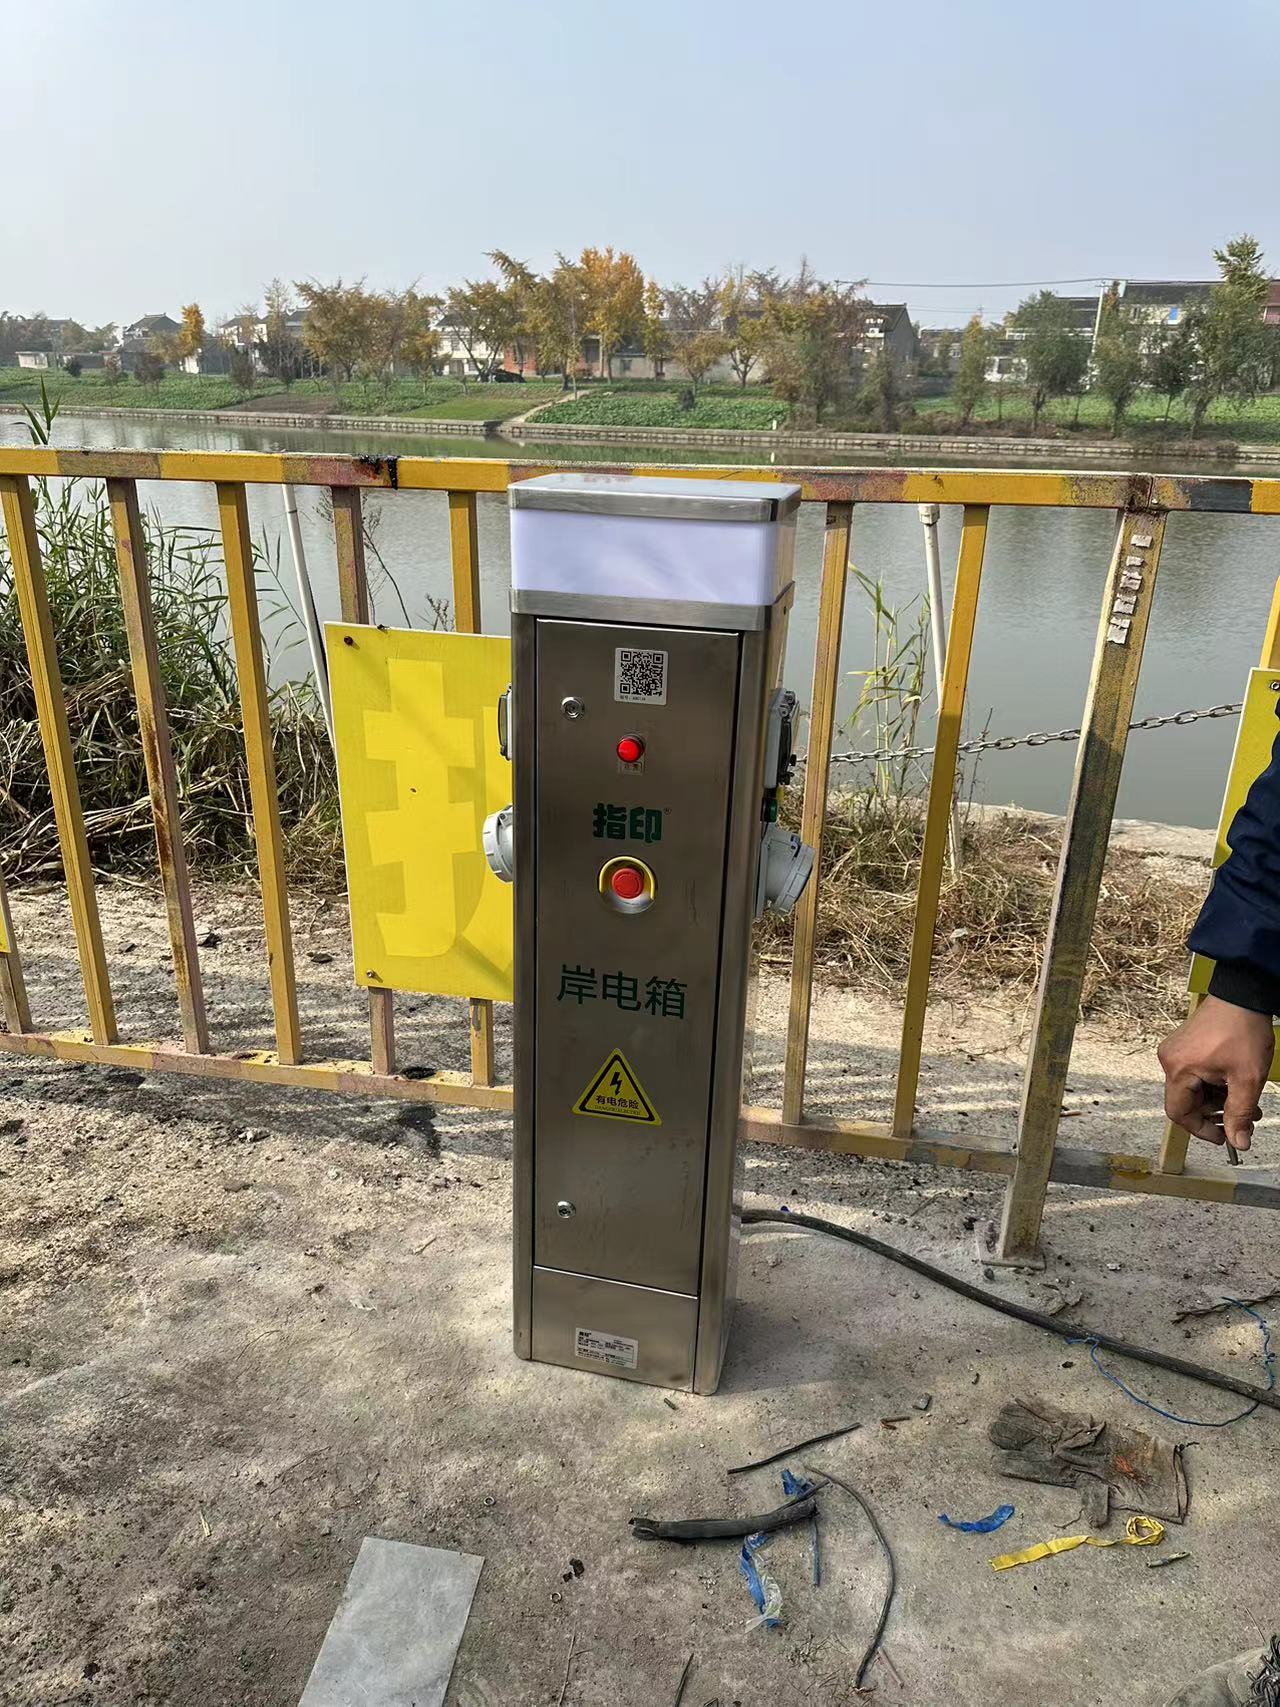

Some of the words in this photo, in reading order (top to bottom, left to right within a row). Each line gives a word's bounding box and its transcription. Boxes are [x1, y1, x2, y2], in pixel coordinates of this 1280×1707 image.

[557, 964, 687, 1019] 岸电箱
[596, 1095, 639, 1109] 有电危险
